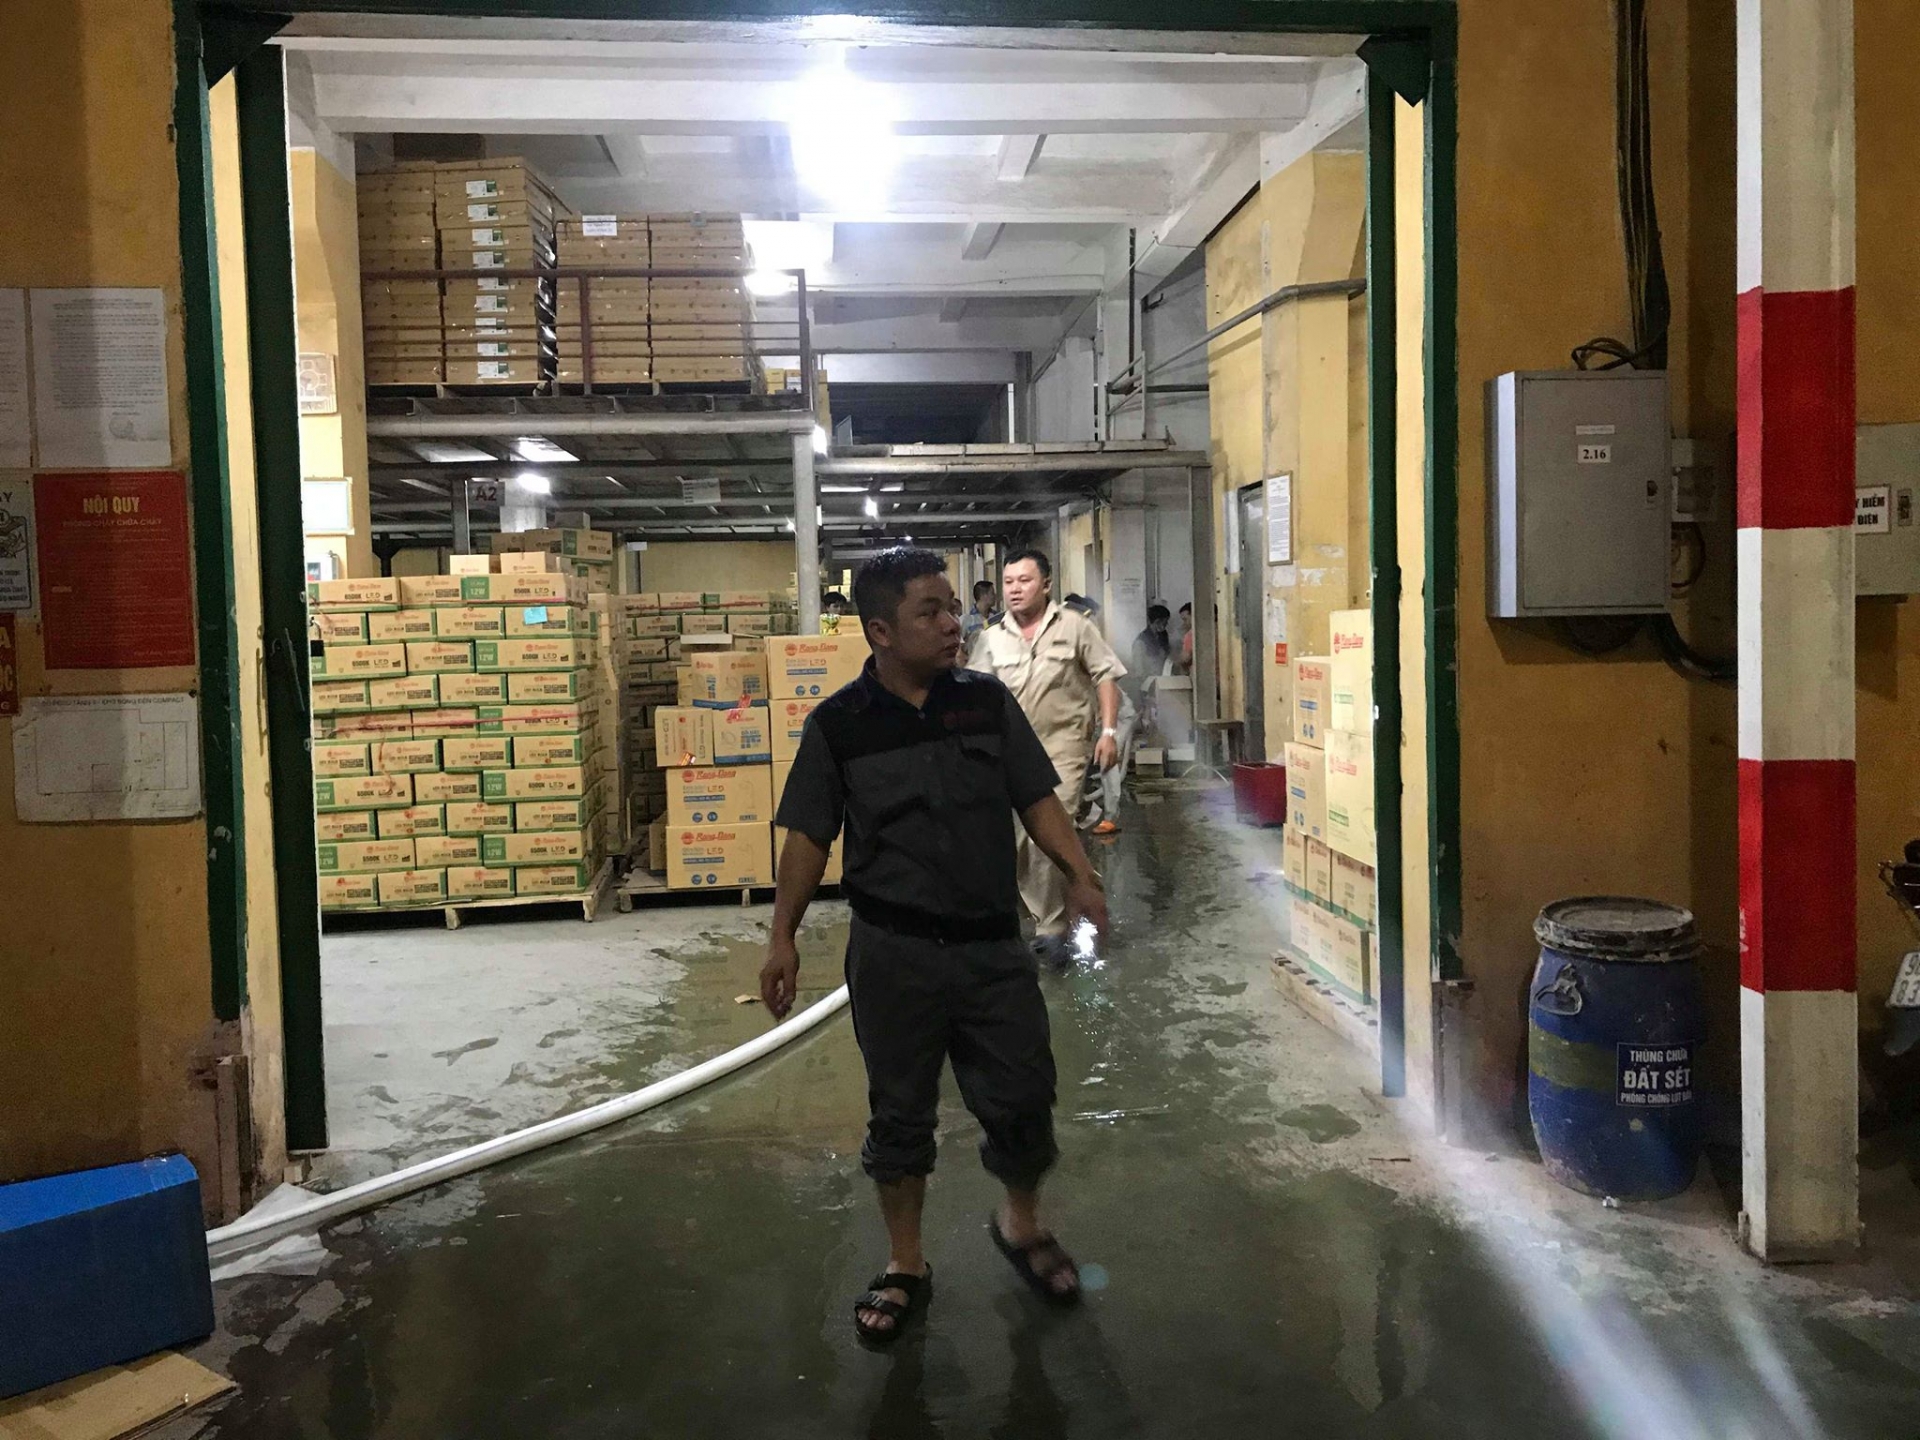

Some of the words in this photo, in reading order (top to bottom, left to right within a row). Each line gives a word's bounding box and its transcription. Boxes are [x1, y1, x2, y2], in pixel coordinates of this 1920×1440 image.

[1583, 449, 1606, 459] 2.16
[475, 486, 497, 501] A2
[83, 494, 108, 517] NỘI
[112, 496, 140, 515] QUY
[707, 785, 725, 793] LED
[706, 847, 724, 855] LED
[1630, 1048, 1664, 1062] THÙNG
[1623, 1065, 1660, 1089] ĐẤT
[1664, 1066, 1691, 1089] SÉT
